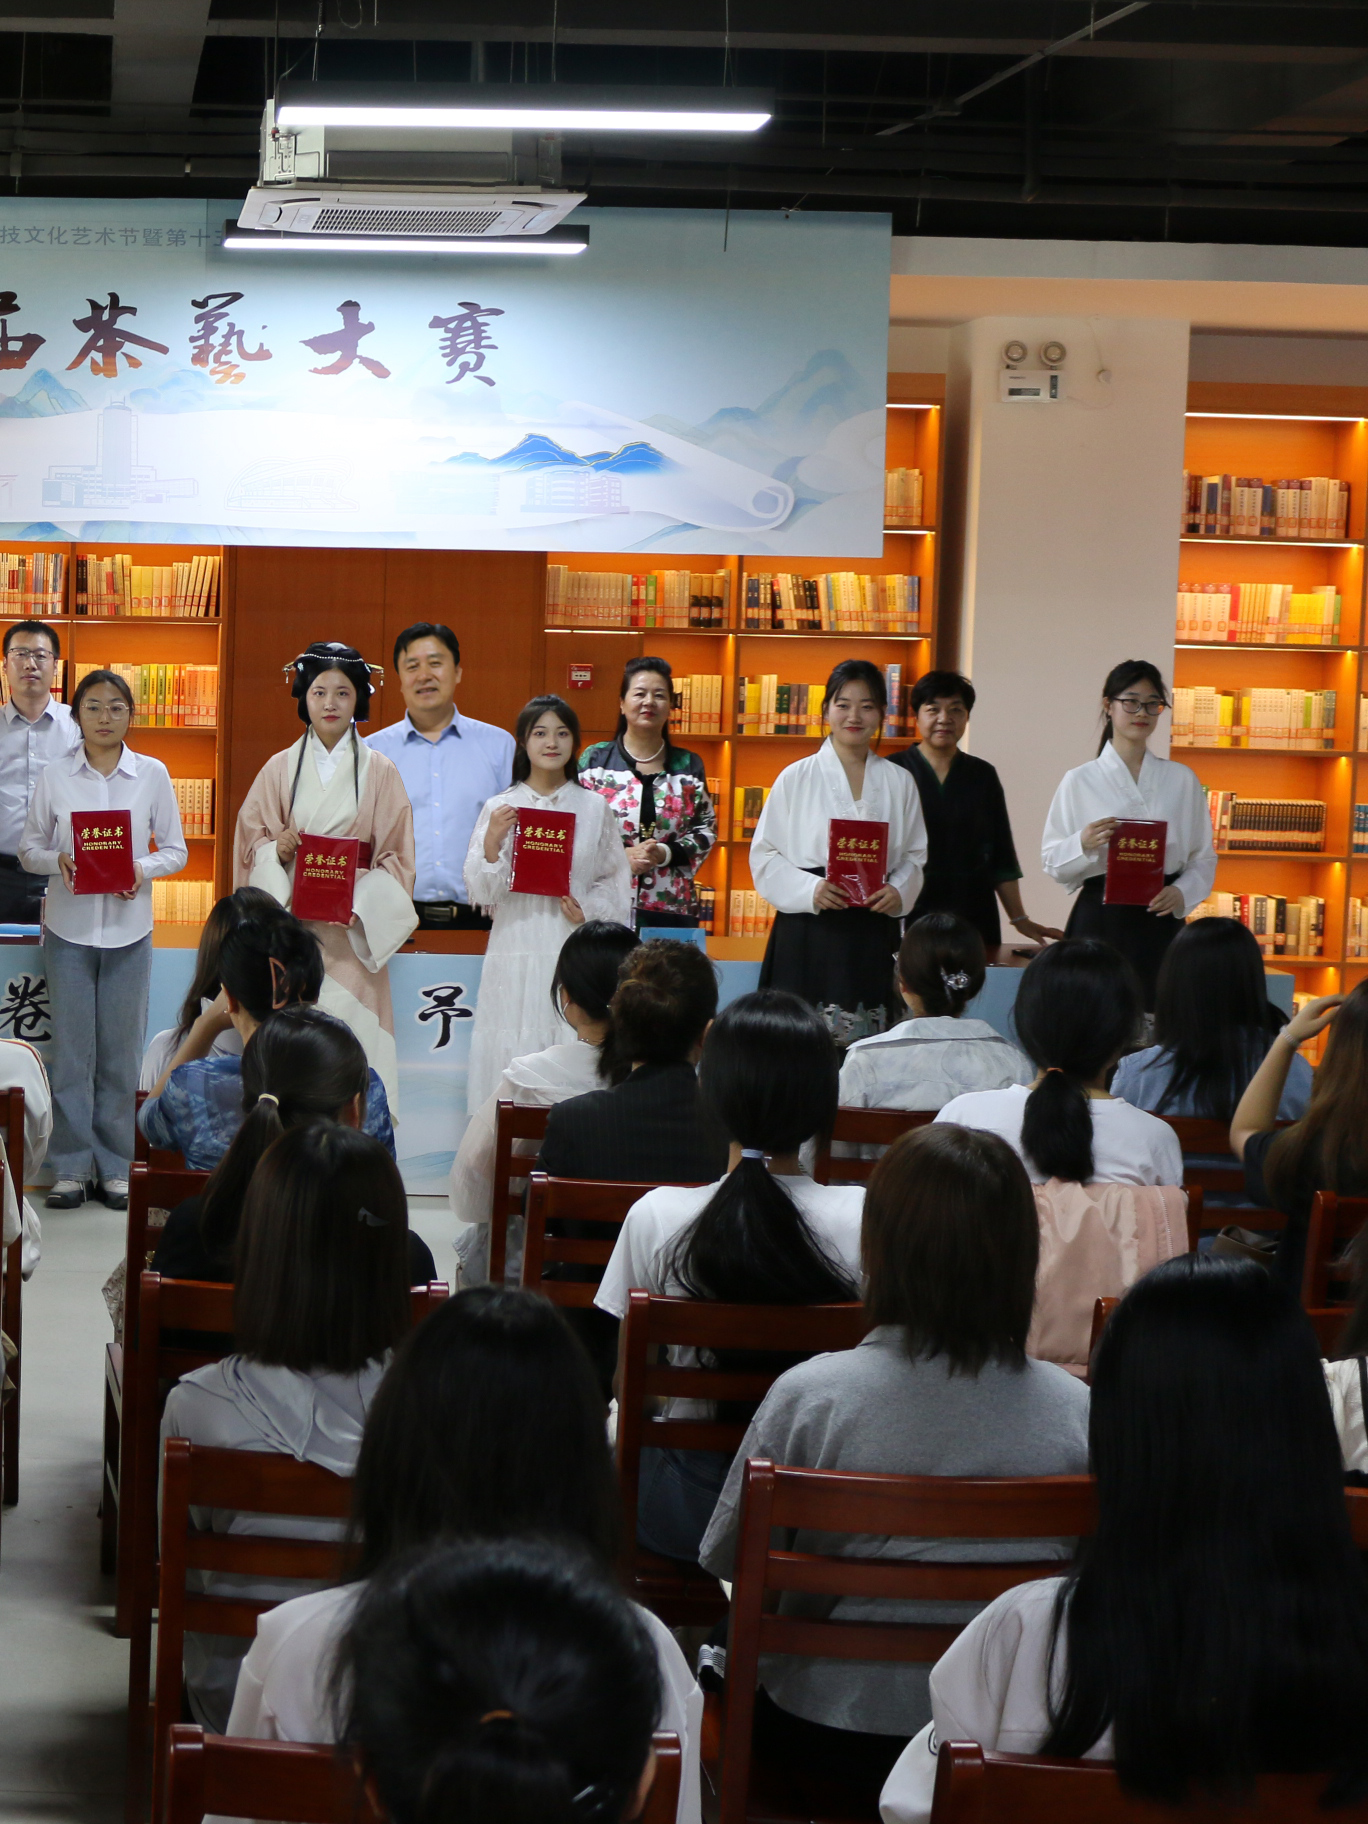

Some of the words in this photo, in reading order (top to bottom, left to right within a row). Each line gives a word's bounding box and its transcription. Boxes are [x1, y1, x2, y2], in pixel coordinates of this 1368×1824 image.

[81, 826, 124, 839] 荣誉证书
[523, 825, 566, 841] 荣誉证书
[522, 844, 565, 853] CREDENTIAL
[525, 840, 564, 849] HONORARY
[837, 837, 880, 851] 荣誉证书
[304, 853, 347, 867] 荣誉证书
[303, 872, 346, 880] CREDENTIAL
[418, 985, 473, 1050] 予
